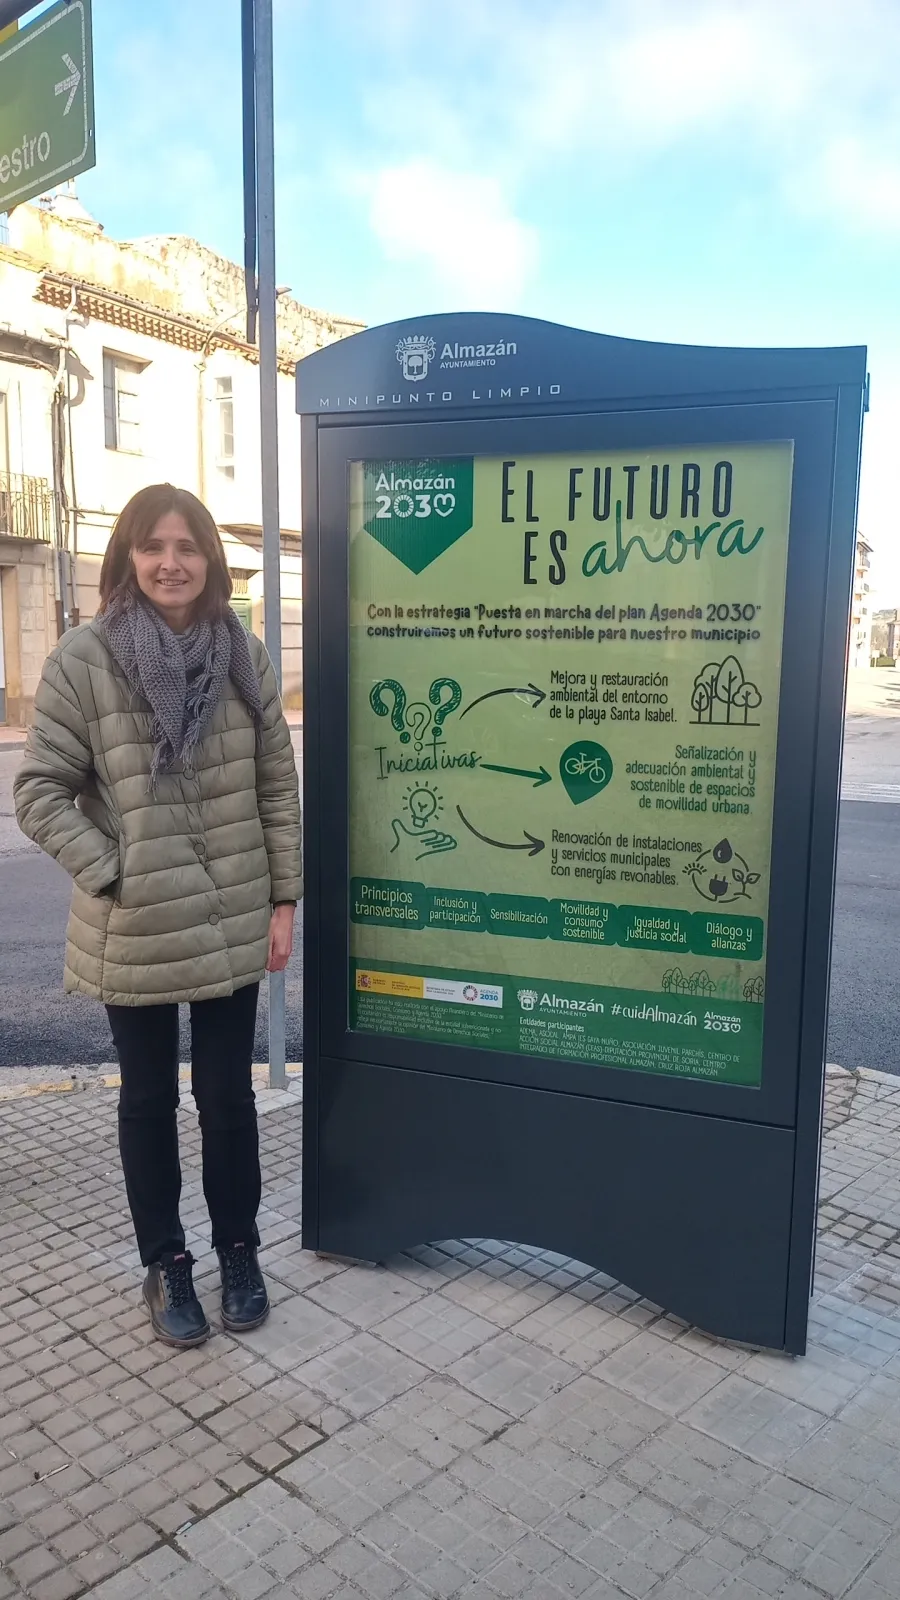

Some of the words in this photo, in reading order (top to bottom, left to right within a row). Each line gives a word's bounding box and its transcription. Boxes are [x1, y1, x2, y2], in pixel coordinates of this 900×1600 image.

[440, 340, 517, 359] Almazán
[440, 359, 496, 369] AYUNTAMIENTO
[319, 391, 452, 407] MINIPUNTO
[472, 384, 561, 399] LIMPIO
[375, 472, 455, 491] Almazán
[501, 461, 539, 522] EL
[568, 461, 732, 521] FUTURO
[523, 530, 567, 585] ES
[582, 500, 764, 577] ahora
[367, 603, 391, 620] Con
[394, 604, 403, 618] la
[407, 604, 471, 620] estrategia
[525, 607, 540, 618] en
[544, 605, 591, 619] marcha
[595, 605, 615, 620] del
[619, 605, 645, 622] plan
[650, 603, 702, 622] Agenda
[706, 603, 761, 622] 2030"
[367, 624, 456, 639] construiremos
[459, 627, 474, 638] un
[478, 624, 522, 639] futuro
[525, 625, 594, 640] sostenible
[598, 628, 626, 643] para
[631, 626, 686, 640] nuestro
[691, 628, 760, 644] municipio
[550, 670, 586, 689] Mejora
[590, 675, 597, 690] y
[601, 672, 668, 686] restauración
[550, 689, 598, 702] ambiental
[602, 689, 617, 701] del
[622, 691, 668, 704] entorno
[550, 705, 561, 718] de
[565, 706, 574, 719] la
[578, 706, 606, 725] playa
[610, 707, 640, 721] Santa
[645, 708, 677, 722] Isabel.
[374, 735, 482, 780] Iniciativas
[675, 745, 743, 761] Señalización
[750, 750, 756, 767] y
[625, 760, 686, 775] adecuación
[691, 763, 744, 779] ambiental
[748, 768, 755, 785] y
[630, 779, 685, 793] sostenible
[689, 780, 702, 794] de
[706, 784, 755, 800] espacios
[639, 795, 651, 808] de
[656, 797, 707, 811] movilidad
[712, 799, 753, 814] urbana.
[552, 829, 611, 845] Renovación
[616, 834, 628, 847] de
[632, 835, 703, 852] instalaciones
[551, 849, 558, 864] y
[562, 849, 606, 863] servicios
[610, 853, 670, 871] municipales
[551, 865, 570, 876] con
[574, 866, 616, 884] energías
[361, 885, 413, 906] Principios
[433, 896, 468, 909] Inclusión
[471, 901, 477, 914] y
[355, 901, 419, 920] transversales
[429, 910, 481, 924] participación
[490, 909, 548, 924] Sensibilización
[560, 903, 599, 917] Movilidad
[603, 908, 609, 921] y
[564, 917, 603, 928] consumo
[634, 916, 670, 934] Igualdad
[673, 921, 680, 934] y
[706, 922, 742, 940] Diálogo
[746, 928, 753, 942] y
[562, 927, 605, 940] sostenible
[625, 927, 658, 941] justicia
[660, 929, 687, 943] social
[711, 938, 746, 951] alianzas
[539, 993, 604, 1013] Almazán
[611, 1002, 697, 1026] #cuidAlmazán
[539, 1008, 587, 1018] AYUNTAMIENTO
[703, 1011, 741, 1022] Almazán
[519, 1017, 546, 1028] Entidades
[547, 1021, 585, 1034] participantes
